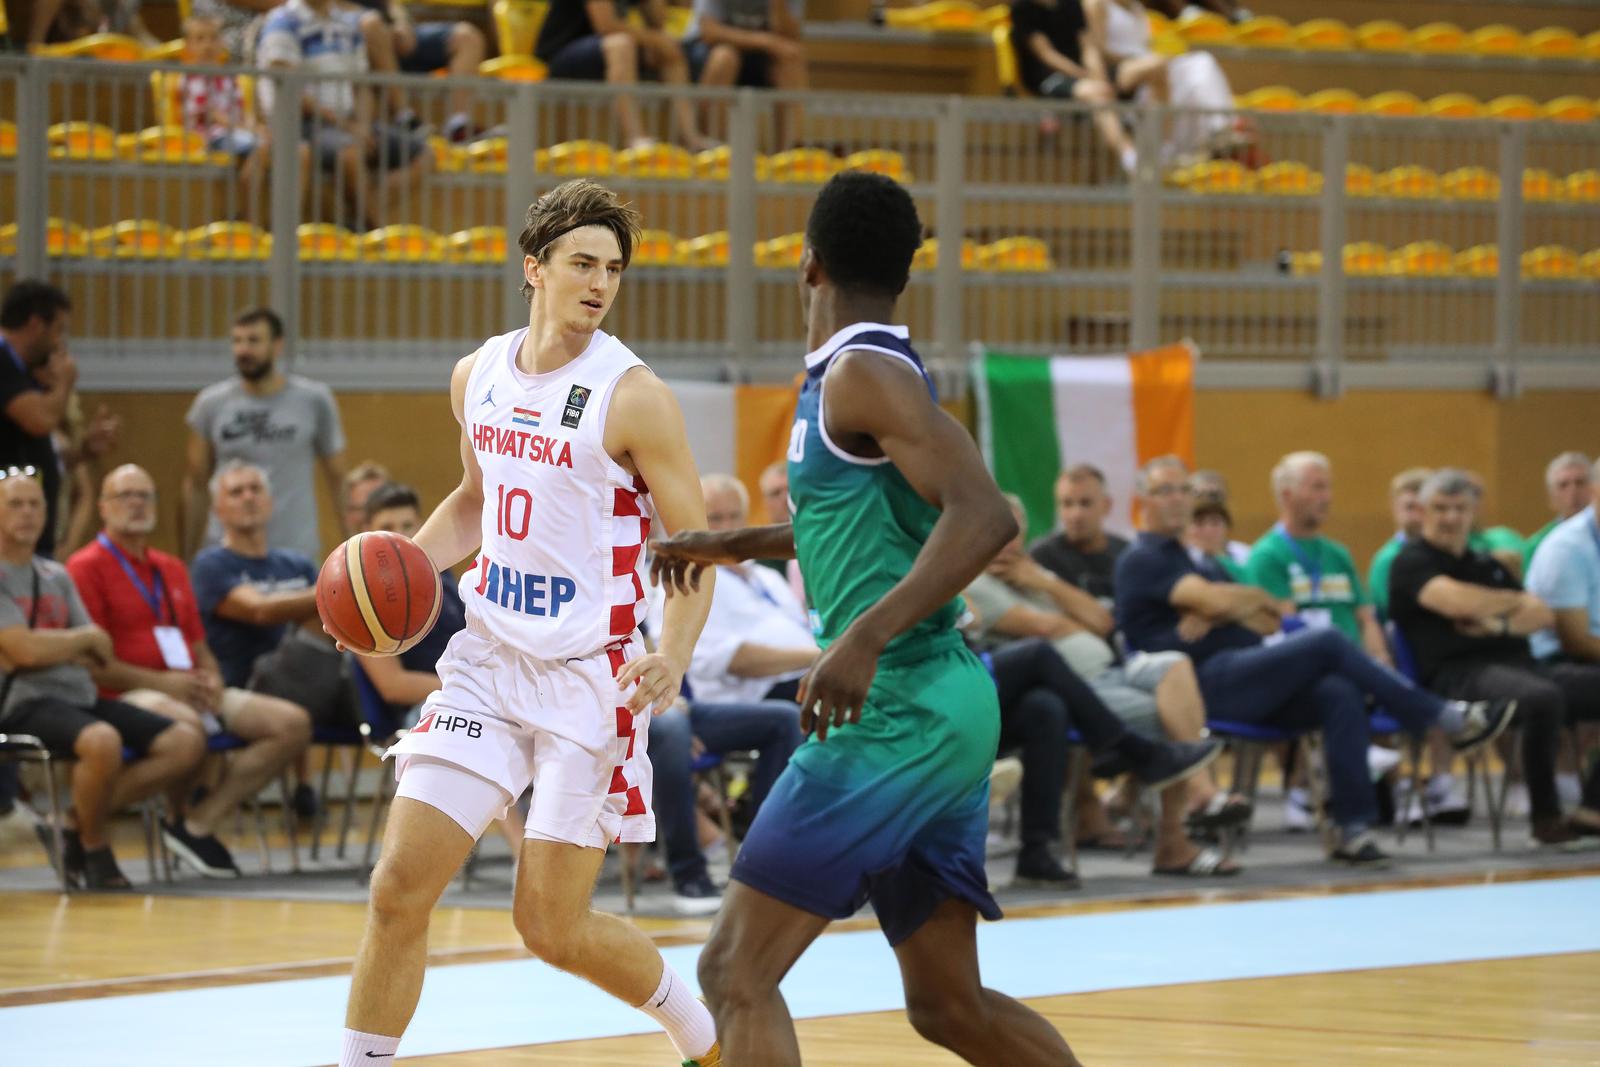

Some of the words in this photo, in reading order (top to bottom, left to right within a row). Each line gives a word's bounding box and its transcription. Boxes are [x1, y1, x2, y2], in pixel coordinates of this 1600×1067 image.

[566, 408, 580, 419] FIBA
[473, 423, 573, 469] HRVATSKA
[497, 484, 533, 541] 10
[500, 567, 576, 618] HEP
[434, 715, 483, 739] HPB
